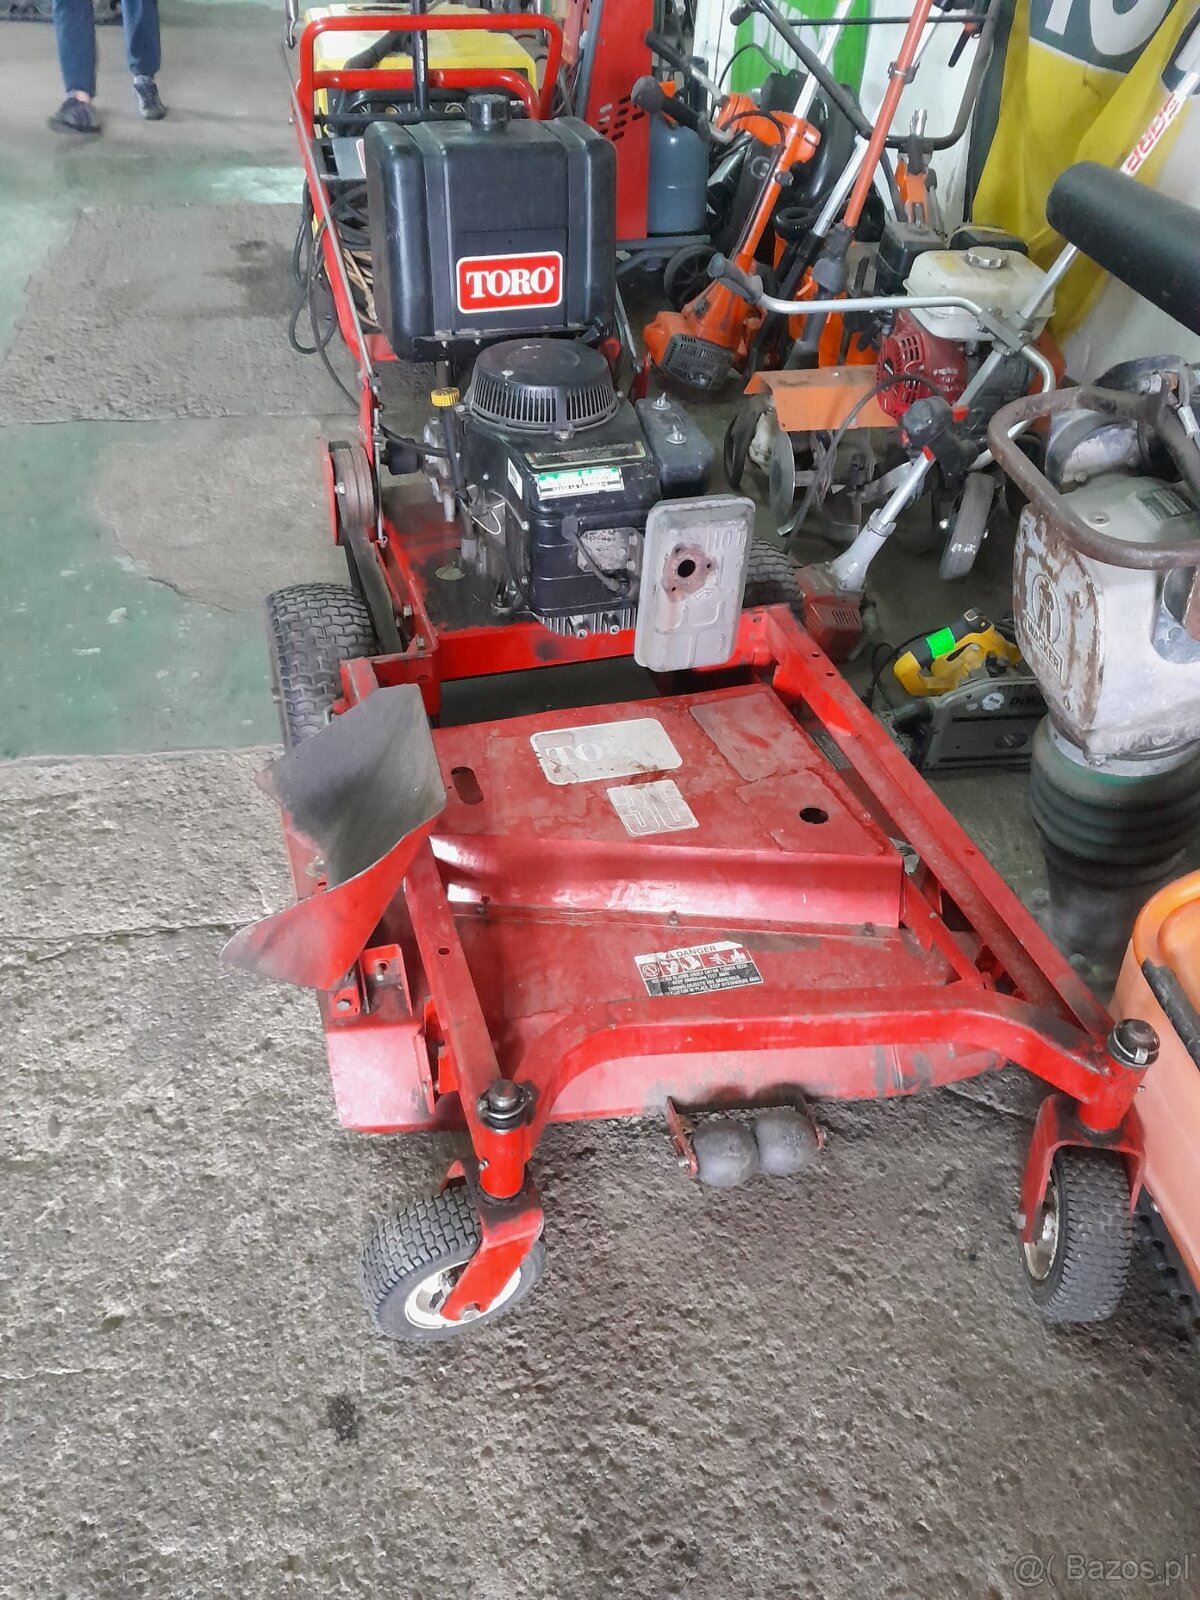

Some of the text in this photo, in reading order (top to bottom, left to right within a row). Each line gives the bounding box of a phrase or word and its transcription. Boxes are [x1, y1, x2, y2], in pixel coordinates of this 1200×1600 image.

[466, 267, 554, 298] TORO
[1026, 615, 1061, 672] WACKER
[545, 743, 604, 766] TO
[676, 945, 717, 957] DANGER
